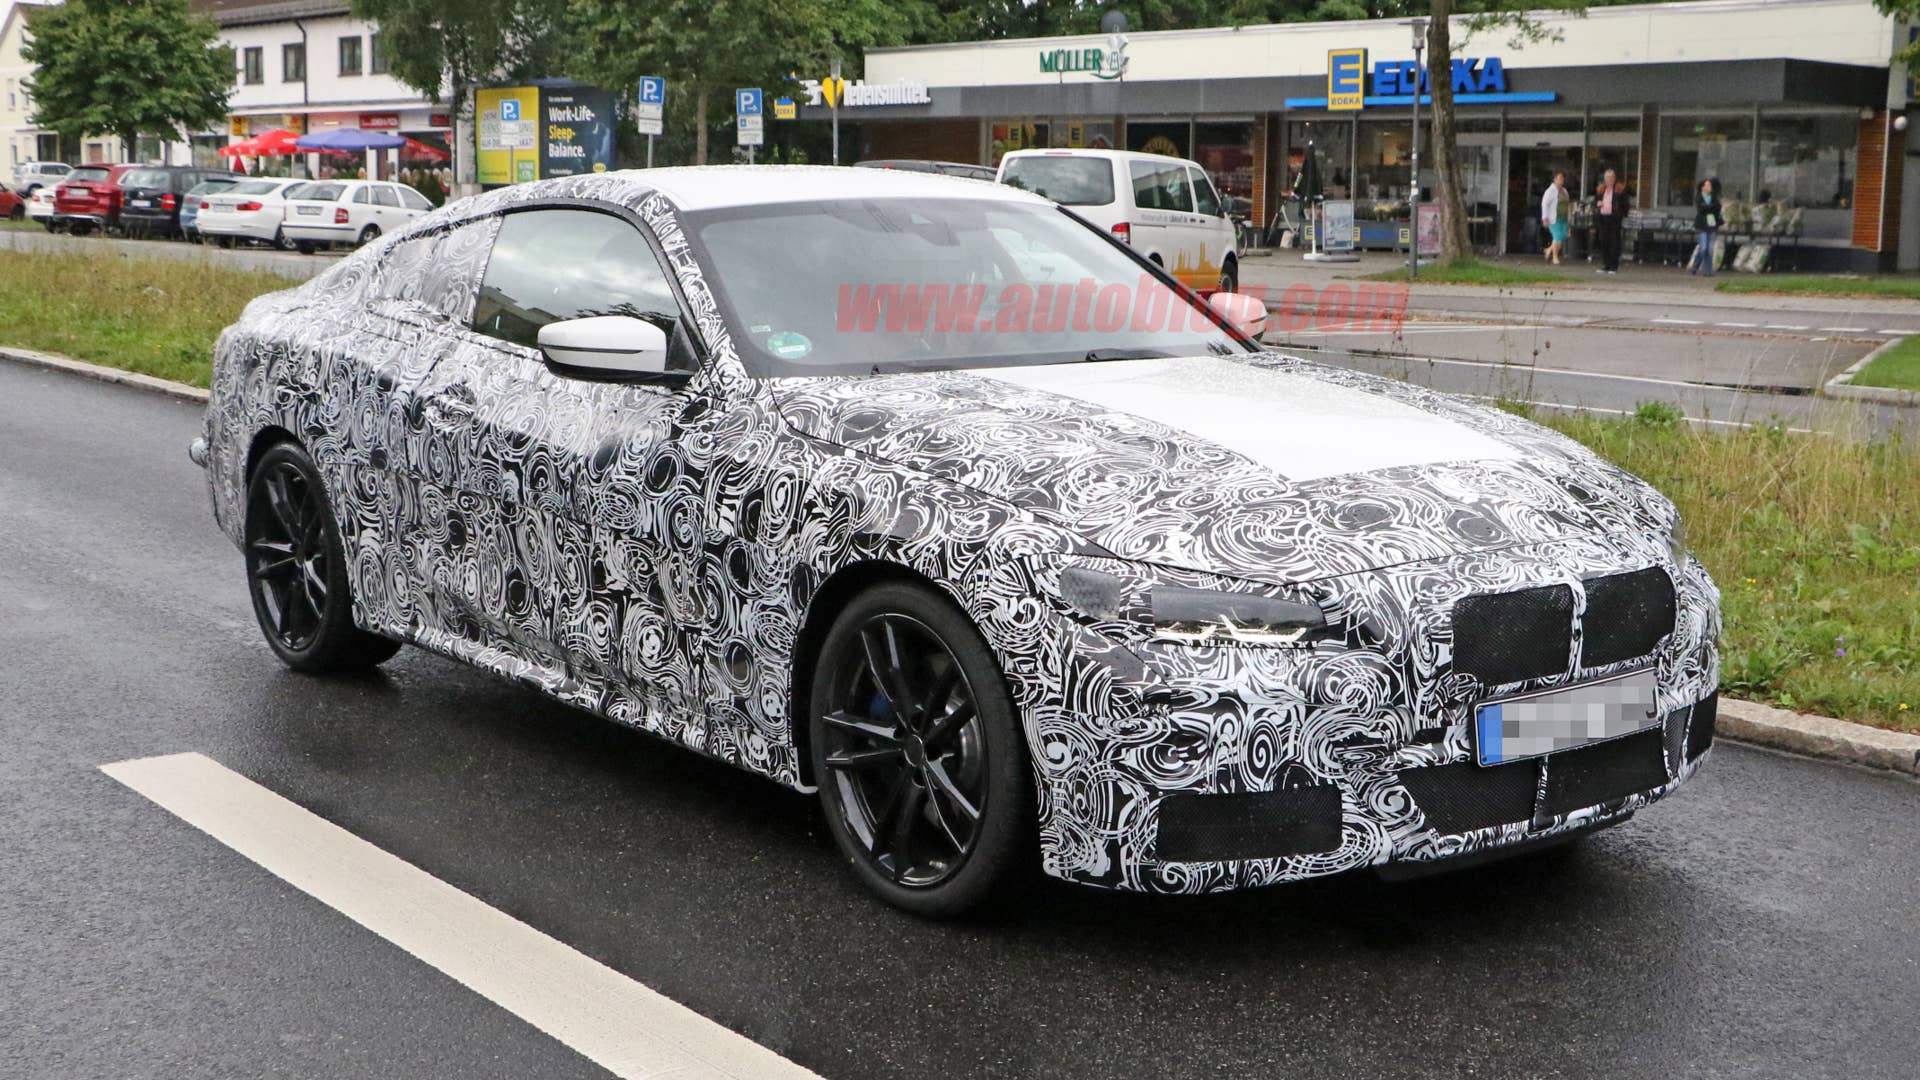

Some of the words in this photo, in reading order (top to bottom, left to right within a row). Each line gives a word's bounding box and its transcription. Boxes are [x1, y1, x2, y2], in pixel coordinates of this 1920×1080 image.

[1040, 48, 1103, 72] MÜLLER
[1332, 54, 1360, 94] E
[1374, 57, 1505, 94] EDKA
[643, 79, 657, 100] P
[503, 102, 515, 119] P
[740, 92, 755, 112] P
[1331, 97, 1361, 105] EDEKA
[548, 105, 596, 122] Work-Life-
[548, 124, 577, 143] Sleep-
[548, 142, 586, 158] Balance.
